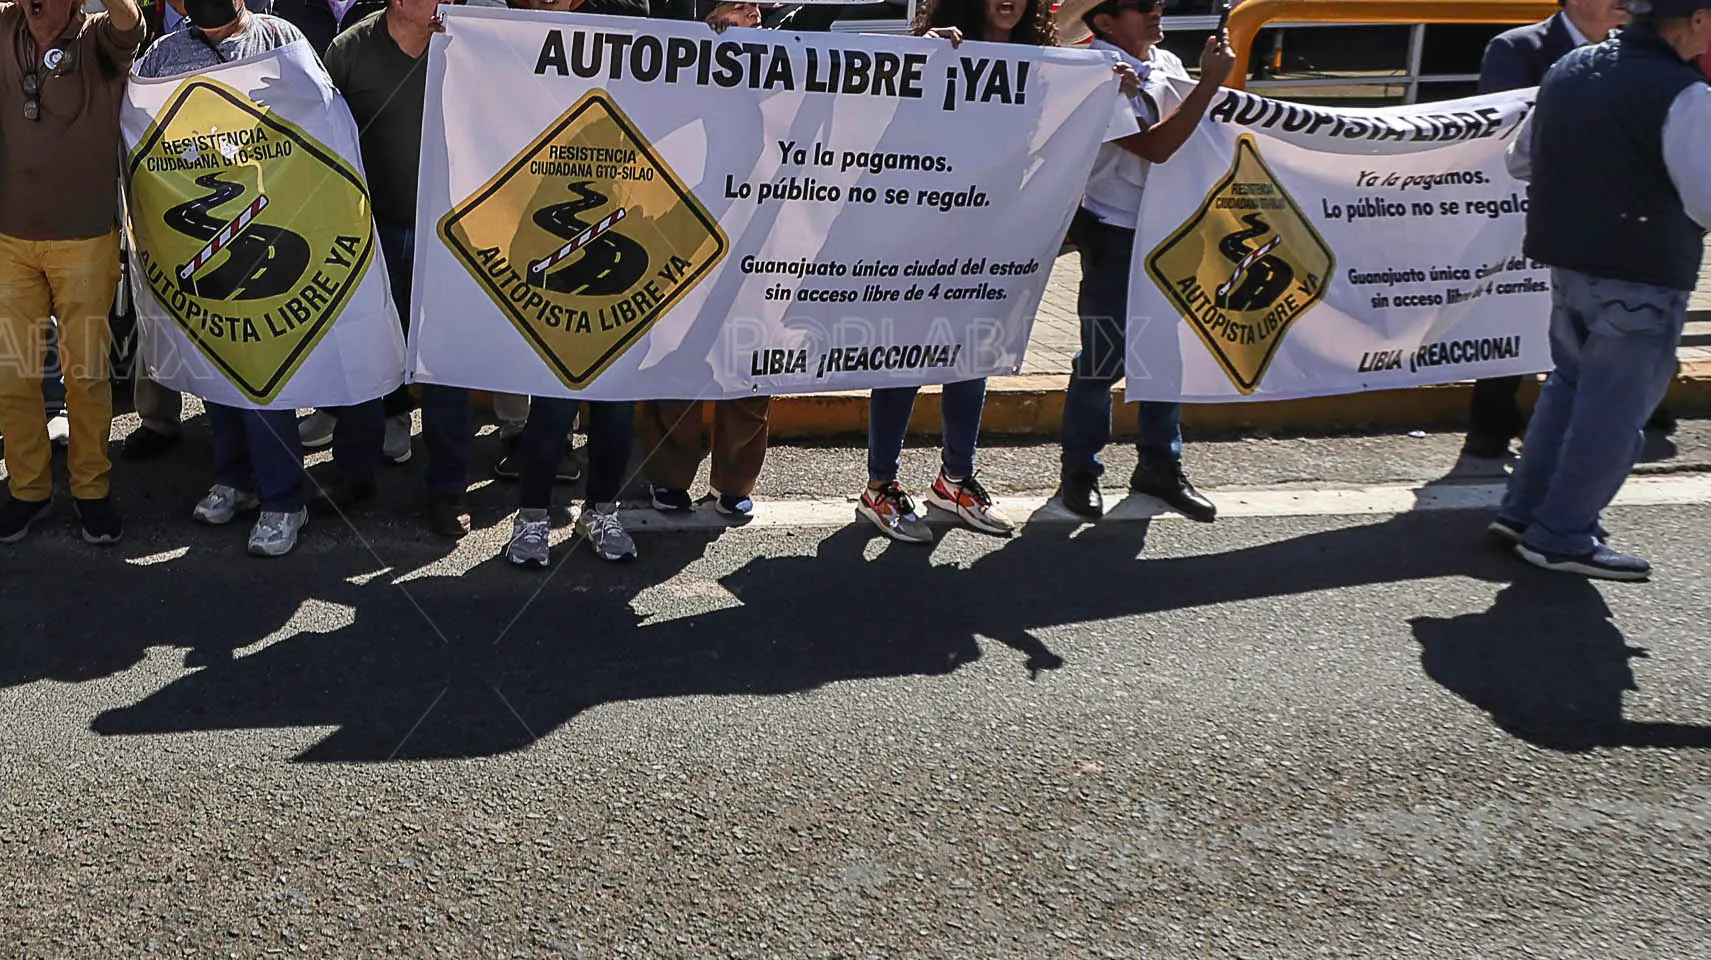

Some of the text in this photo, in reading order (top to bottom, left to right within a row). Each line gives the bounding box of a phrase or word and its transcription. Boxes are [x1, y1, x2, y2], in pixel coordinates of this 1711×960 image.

[535, 29, 1030, 112] AUTOPISTA LIBRE ¡YA!
[1406, 108, 1502, 141] LIBRE
[161, 127, 268, 155] RESISTENCIA
[549, 145, 637, 164] RESISTENCIA
[530, 161, 654, 182] CIUDADANA GTO-SILAO
[778, 141, 953, 174] Ya la pagamos.
[724, 175, 991, 211] Lo público no se regala.
[1356, 168, 1491, 191] Ya la pagamos.
[1322, 197, 1342, 219] Lo
[1347, 196, 1407, 223] público
[1412, 200, 1434, 216] no
[1440, 200, 1460, 215] se
[740, 256, 1040, 278] Guanajuato única ciudad del estado
[1348, 268, 1426, 287] Guanajuato
[1430, 265, 1471, 281] única
[141, 235, 362, 342] AUTOPISTA LIBRE YA
[476, 246, 693, 334] AUTOPISTA LIBRE YA
[765, 282, 1008, 302] sin acceso libre de 4 carriles.
[1371, 292, 1389, 309] sin
[1393, 294, 1443, 307] acceso
[1177, 271, 1319, 345] AUTOPISTA LIBRE YA
[750, 343, 962, 378] LIBIA ¡REACCIONA!
[1358, 335, 1521, 373] LIBIA ¡REACCIONA!
